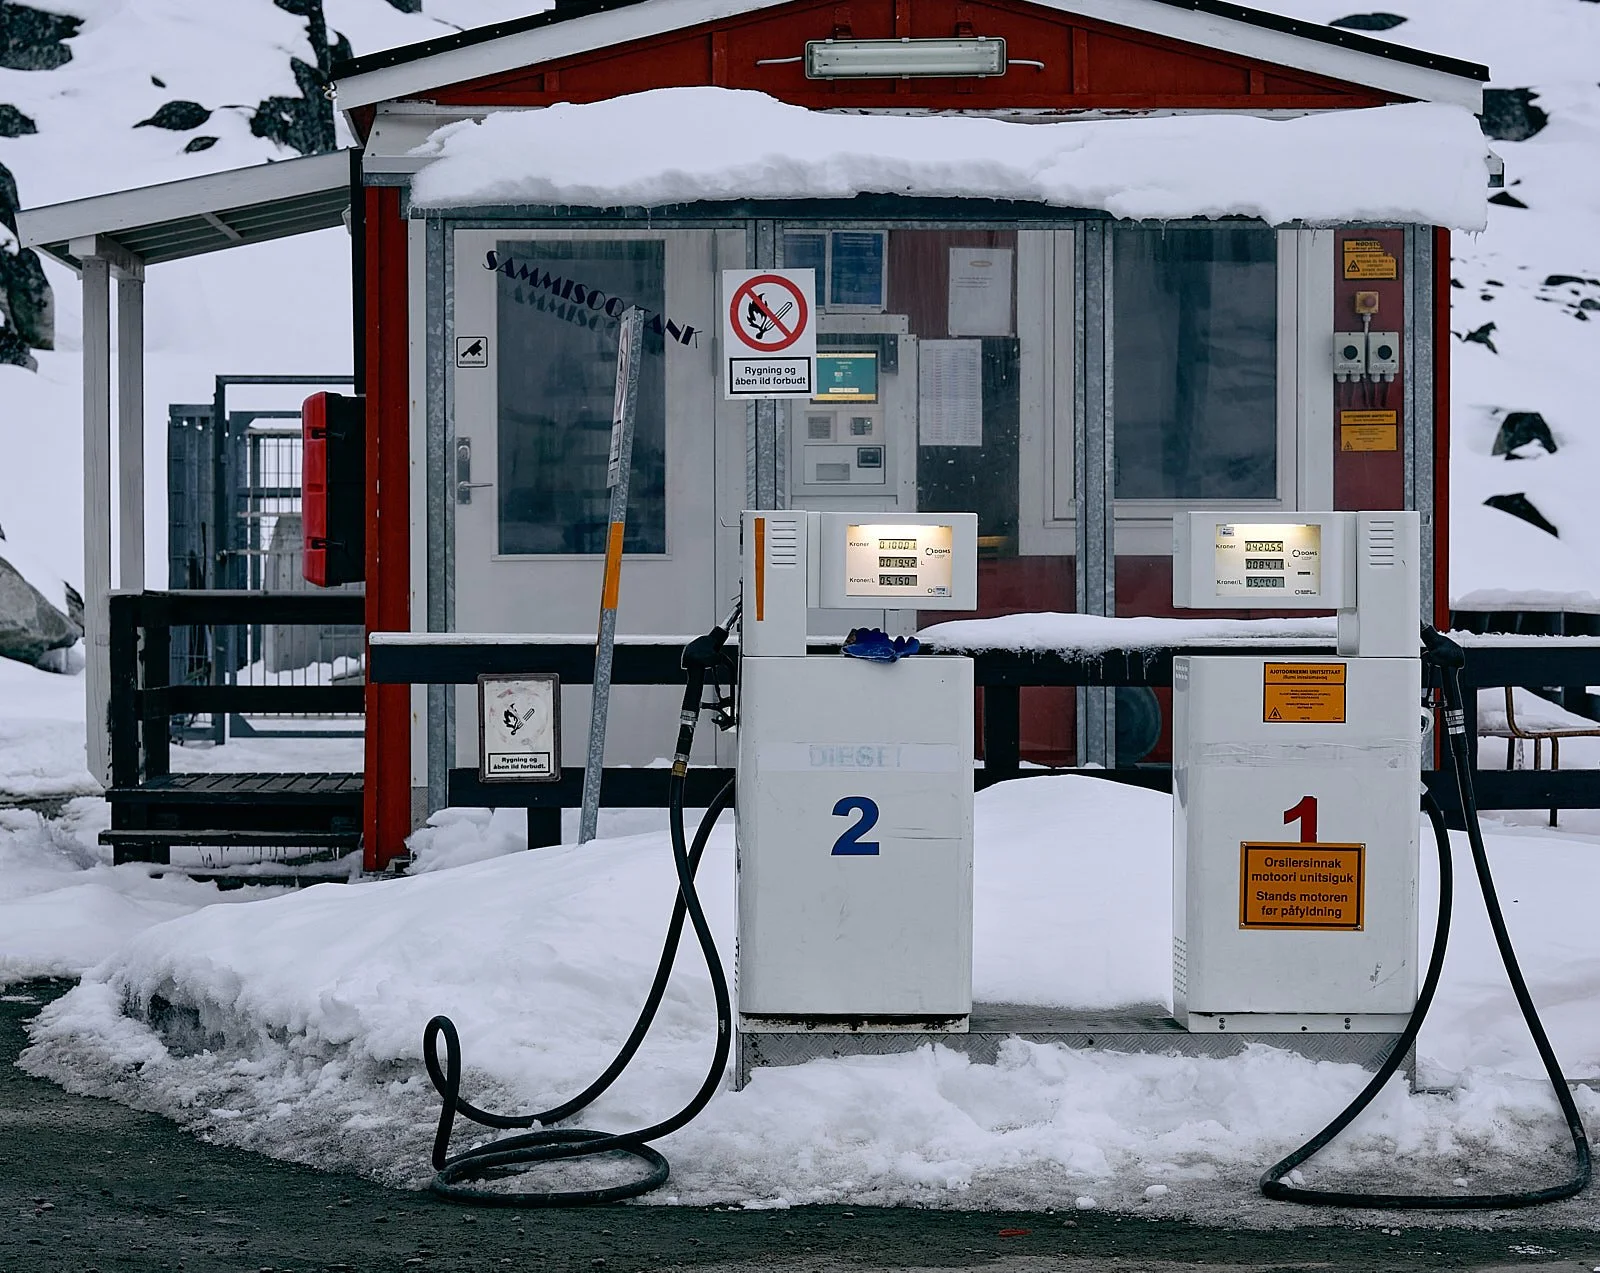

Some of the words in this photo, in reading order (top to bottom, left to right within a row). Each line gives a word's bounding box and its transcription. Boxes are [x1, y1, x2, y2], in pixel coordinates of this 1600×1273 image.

[482, 250, 625, 321] SAMMISOQ
[634, 305, 703, 349] ANK
[744, 366, 782, 376] Rygning
[784, 367, 796, 376] og
[735, 377, 757, 385] åben
[759, 377, 771, 385] ild
[773, 376, 806, 385] forbudt
[1284, 795, 1318, 843] 1
[831, 796, 880, 856] 2
[1264, 857, 1342, 868] Orsilersinnak
[1251, 872, 1297, 882] motoori
[1300, 873, 1354, 885] unitsiguk
[1256, 890, 1297, 902] Stands
[1299, 891, 1348, 902] motoren
[1261, 905, 1278, 916] før
[1281, 905, 1342, 919] påfyldning
